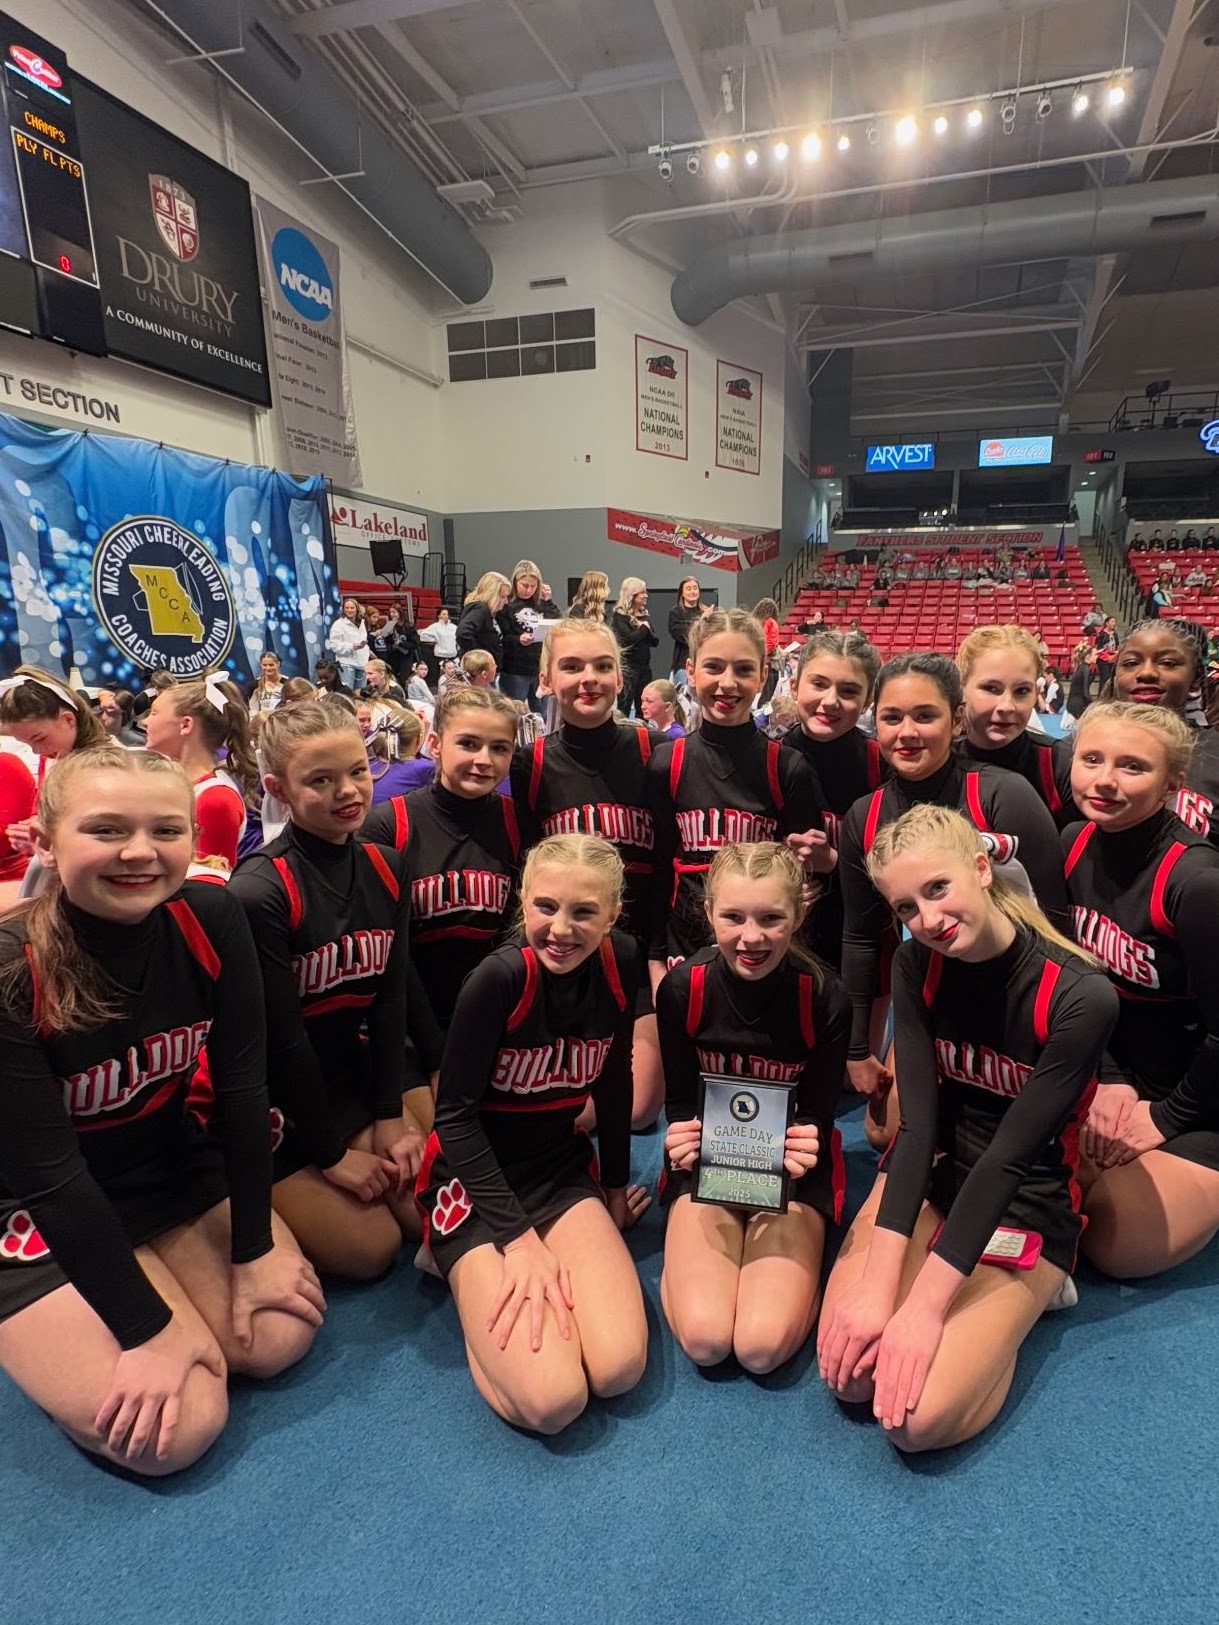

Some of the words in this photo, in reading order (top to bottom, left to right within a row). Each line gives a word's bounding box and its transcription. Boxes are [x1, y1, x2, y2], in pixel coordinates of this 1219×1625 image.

[24, 111, 66, 145] CHAMPS
[16, 133, 38, 155] PLY
[43, 148, 58, 166] FL
[60, 157, 81, 178] PTS
[116, 235, 240, 324] DRURY
[280, 263, 333, 310] NCAA
[136, 287, 233, 338] UNIVERSITY
[272, 310, 300, 331] Men's
[105, 305, 114, 318] A
[117, 309, 189, 346] COMMUNITY
[191, 337, 205, 351] OF
[207, 344, 263, 374] EXCELLENCE
[20, 378, 121, 424] SECTION
[649, 385, 666, 396] NCAA
[644, 407, 680, 426] NATIONAL
[640, 421, 684, 441] CHAMPIONS
[723, 426, 755, 443] NATIONAL
[719, 439, 757, 457] CHAMPIONS
[870, 444, 931, 470] ARVEST
[349, 508, 427, 542] Lakeland
[856, 534, 923, 547] PANTHERS
[925, 533, 984, 546] STUDENT
[986, 532, 1044, 545] SECTION
[102, 528, 144, 596] MISSOURI
[144, 525, 226, 602] CHEERLEADING
[111, 613, 167, 668] COACHES
[169, 617, 229, 674] ASSOCIATION
[714, 1125, 747, 1138] GAME
[750, 1129, 773, 1145] DAY
[710, 1140, 737, 1154] STATE
[739, 1143, 775, 1158] CLASSIC
[711, 1155, 746, 1167] JUNIOR
[748, 1160, 772, 1171] HIGH
[727, 1170, 778, 1188] PLACE
[728, 1187, 750, 1198] 2025
